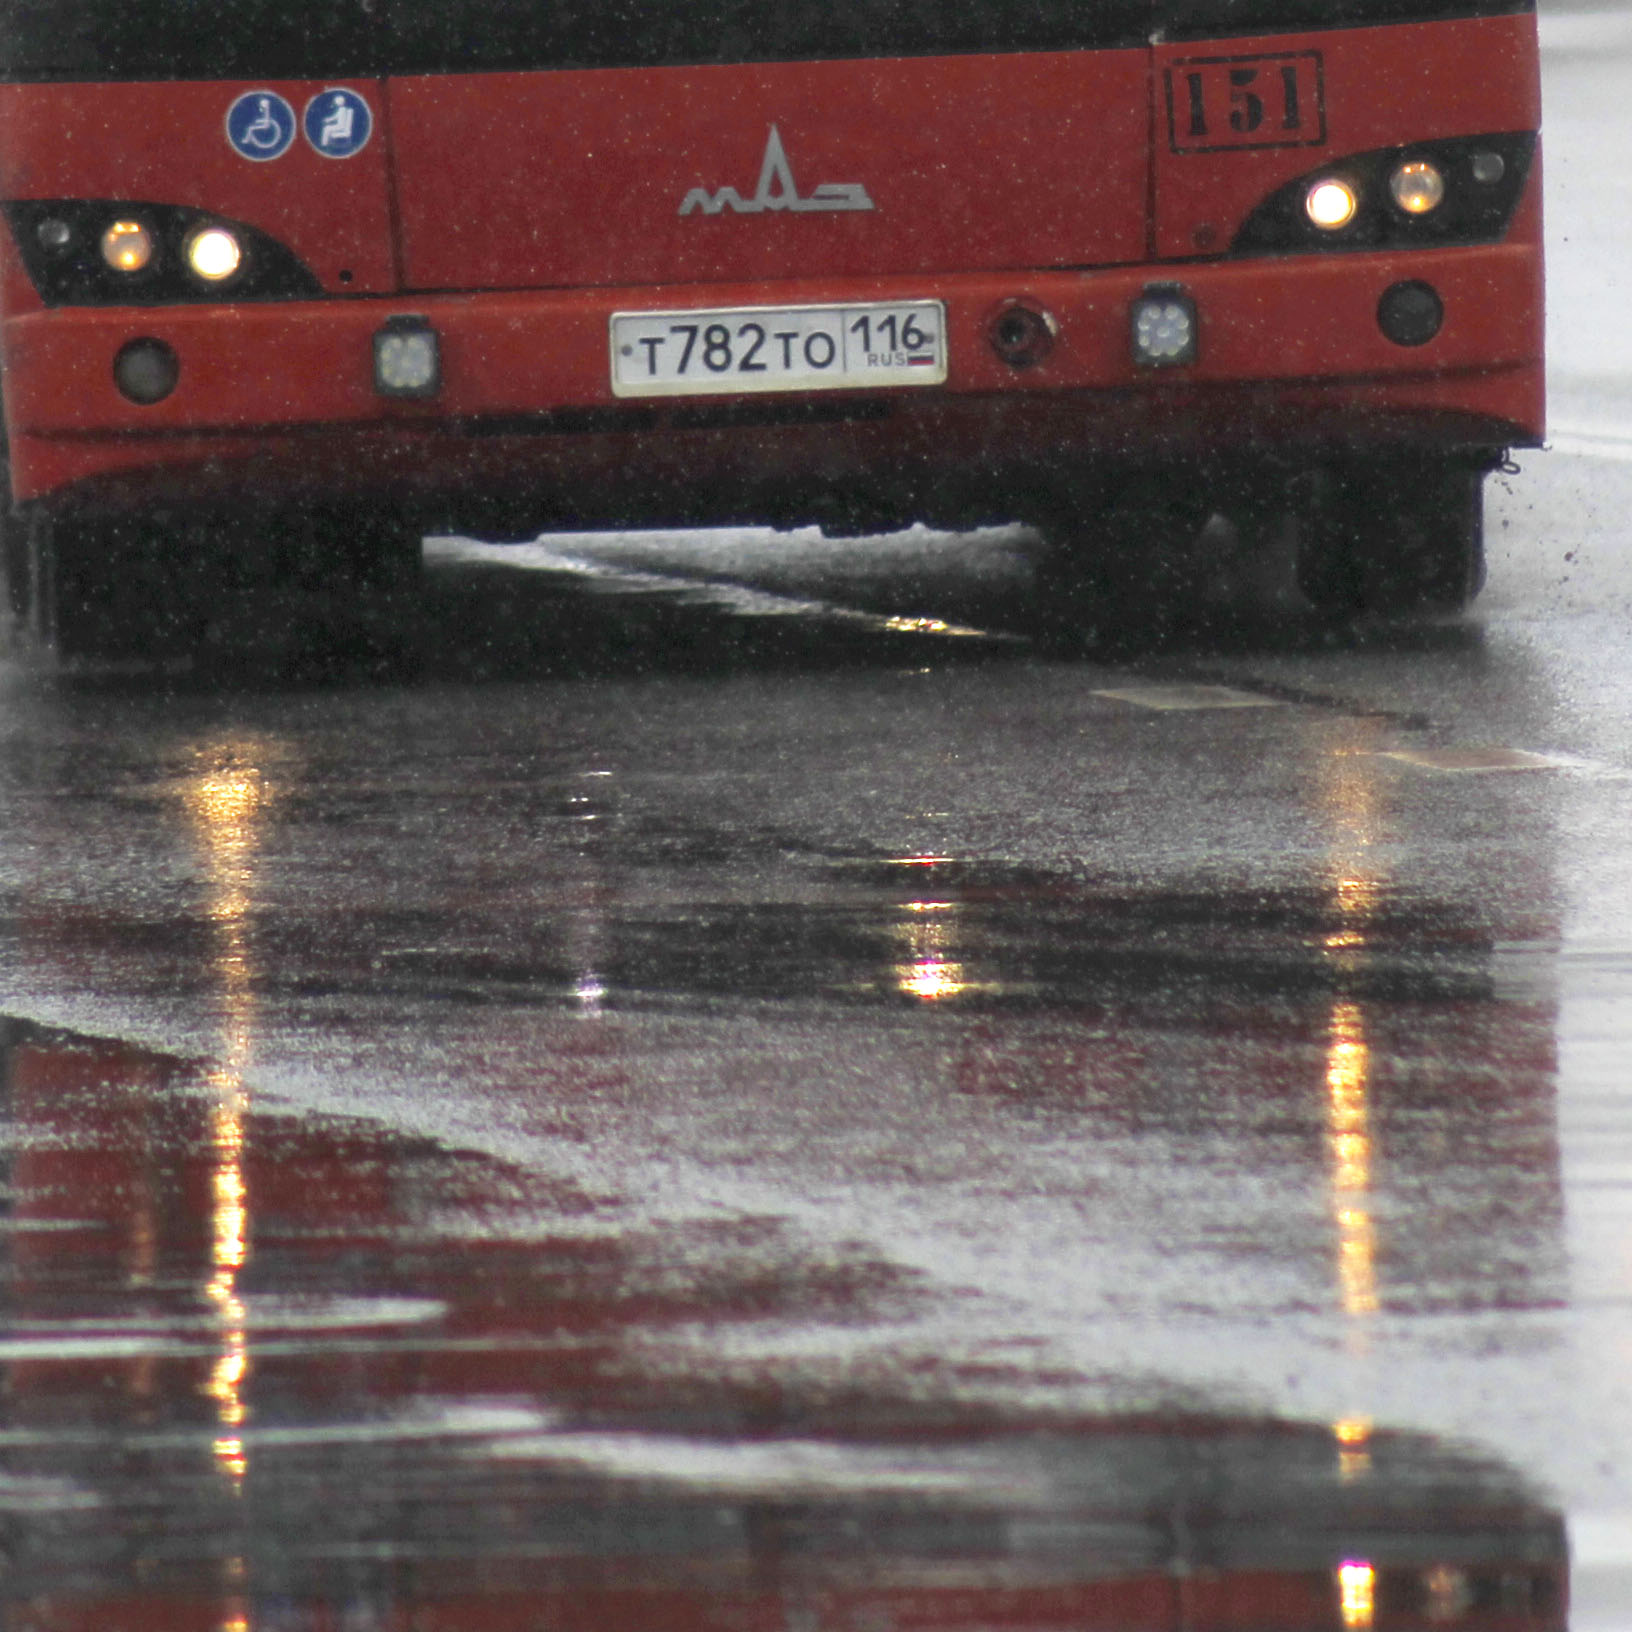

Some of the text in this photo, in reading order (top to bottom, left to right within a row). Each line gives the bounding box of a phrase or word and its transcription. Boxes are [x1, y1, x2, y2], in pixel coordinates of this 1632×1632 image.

[1186, 66, 1300, 136] 151
[638, 313, 925, 376] Т782ТО 116
[867, 352, 906, 367] RUS
